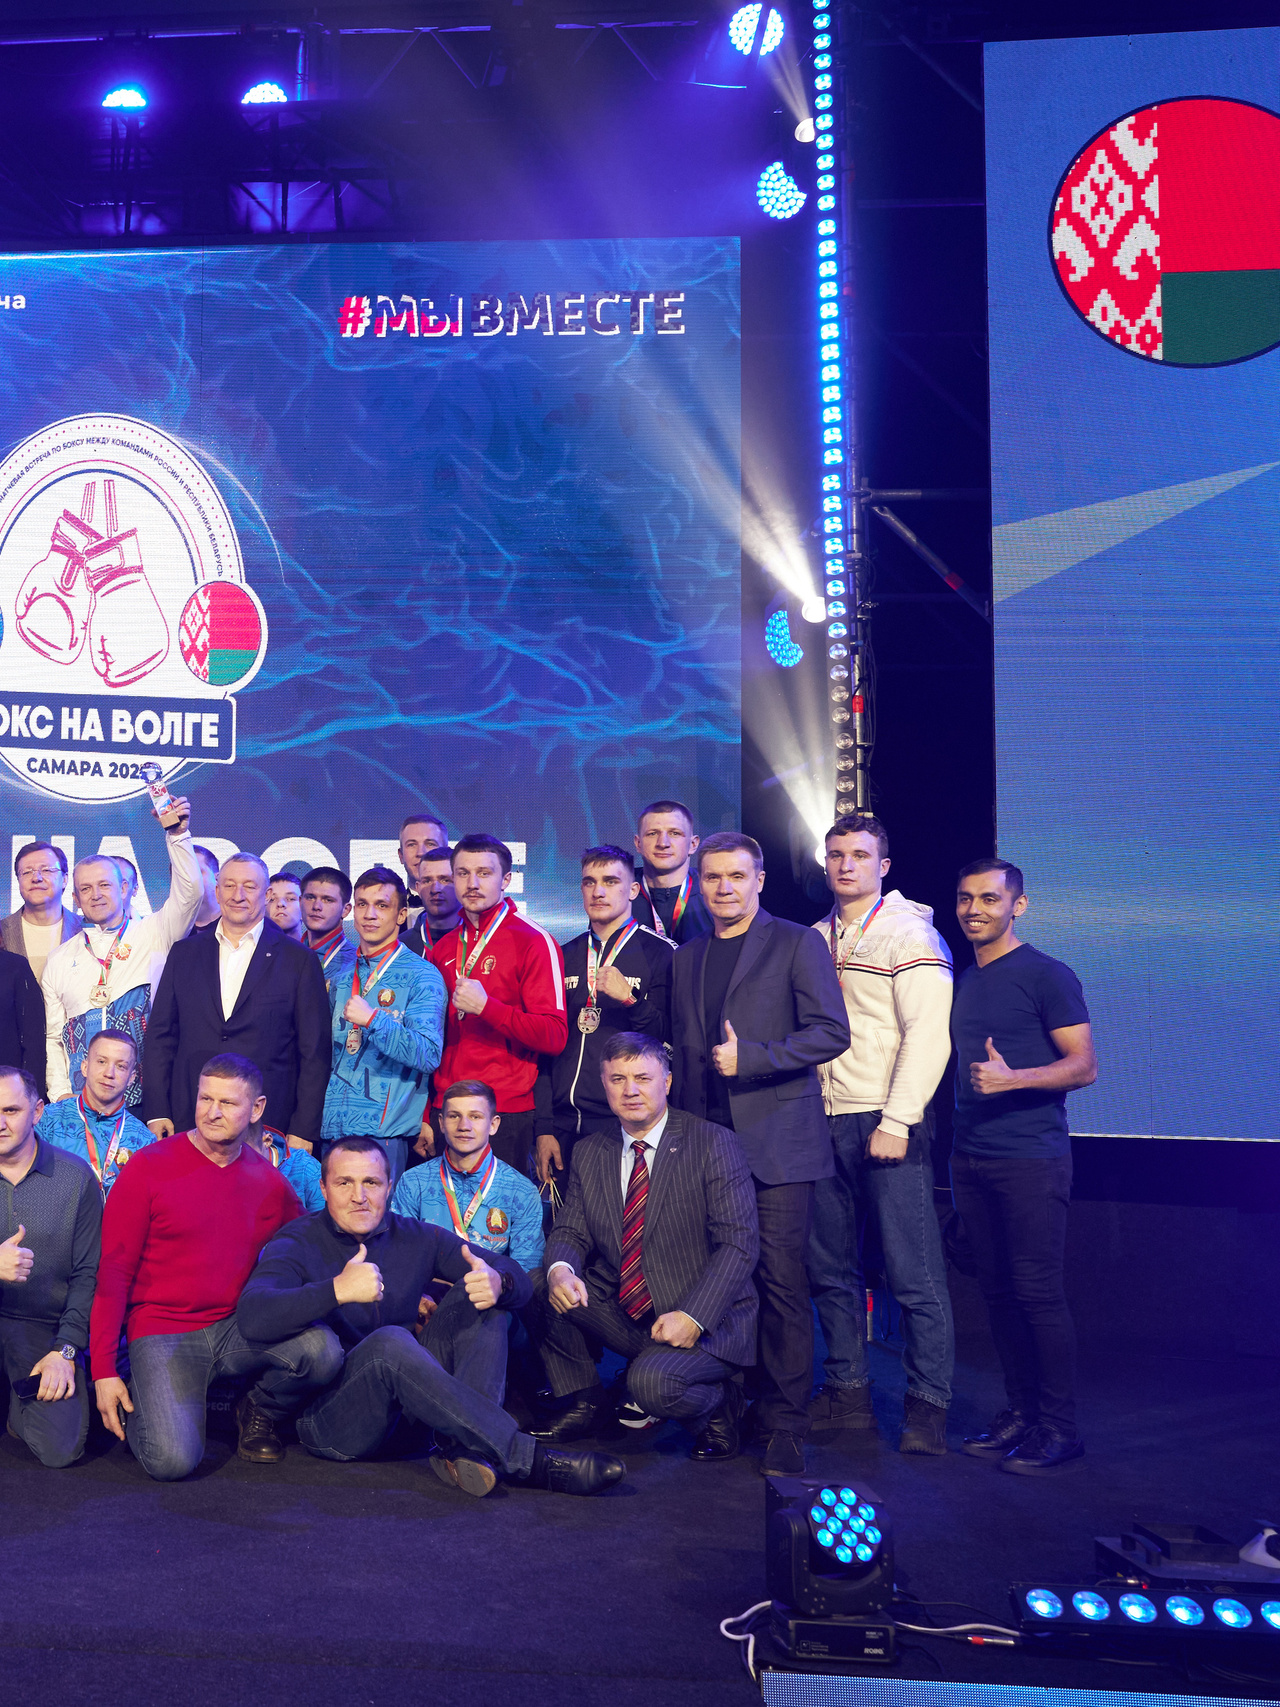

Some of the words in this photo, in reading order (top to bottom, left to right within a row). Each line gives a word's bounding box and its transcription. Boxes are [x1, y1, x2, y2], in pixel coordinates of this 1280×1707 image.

[24, 450, 52, 473] ВСТРЕЧА
[51, 445, 61, 455] ПО
[63, 439, 84, 450] БОКСУ
[86, 436, 110, 445] МЕЖДУ
[111, 438, 154, 459] КОМАНДАМИ
[153, 455, 180, 481] РОССИИ
[183, 484, 212, 533] РЕСПУБЛИКИ
[209, 533, 223, 577] БЕЛАРУСЬ
[61, 706, 105, 742] НА
[111, 708, 220, 748] ВОЛГЕ
[26, 757, 104, 778] САМАРА
[108, 761, 140, 779] 202
